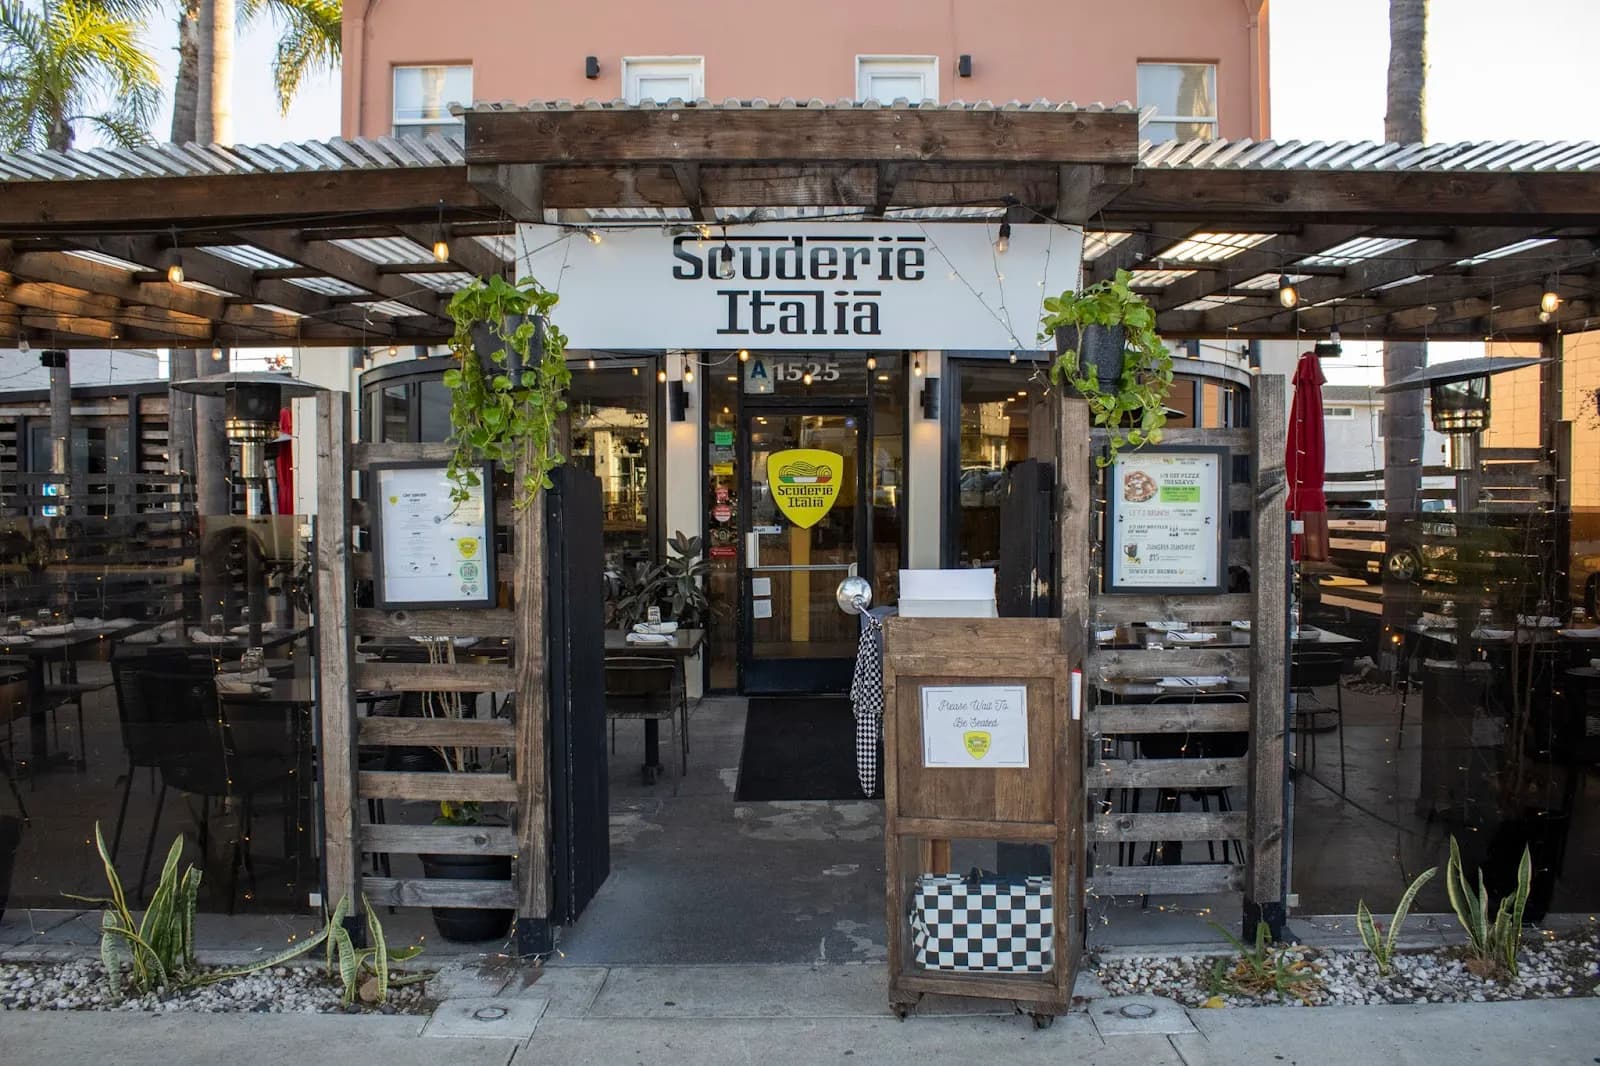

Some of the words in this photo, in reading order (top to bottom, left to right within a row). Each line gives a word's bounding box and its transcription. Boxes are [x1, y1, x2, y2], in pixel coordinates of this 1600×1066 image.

[672, 236, 926, 280] Scuderie
[716, 290, 882, 335] Italia
[750, 359, 768, 379] A
[771, 361, 840, 381] 1525
[777, 484, 834, 496] Scuderie
[787, 496, 824, 508] Italia
[937, 699, 969, 711] Please
[970, 699, 993, 711] Wait
[994, 699, 1009, 711] To
[952, 717, 969, 728] Be
[969, 717, 1000, 728] Seated
